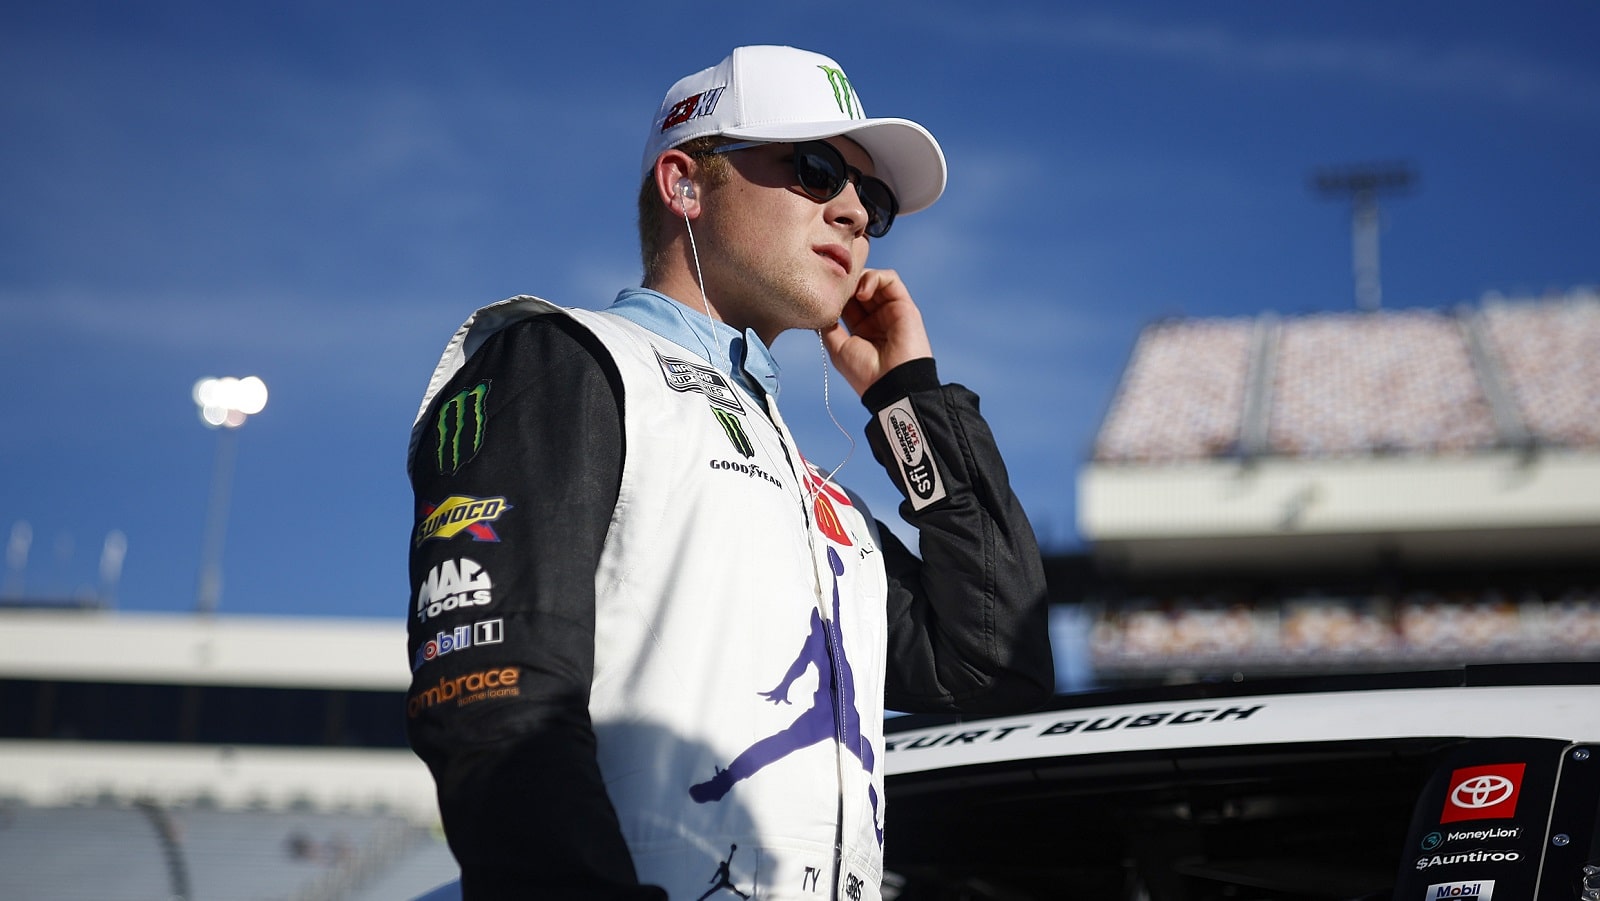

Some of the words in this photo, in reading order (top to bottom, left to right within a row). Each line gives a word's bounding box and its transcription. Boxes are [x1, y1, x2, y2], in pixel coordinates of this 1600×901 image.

[899, 420, 916, 453] CERTIFIED
[709, 459, 783, 490] GOODYEAR
[416, 501, 501, 542] SUNOCO
[417, 557, 492, 612] MAC
[417, 590, 492, 623] TOOLS
[1038, 704, 1266, 737] BUSCH
[1447, 828, 1518, 842] MoneyLion
[1416, 851, 1520, 870] $Auntiroo
[802, 866, 821, 893] TY
[1436, 883, 1482, 898] Mobil
